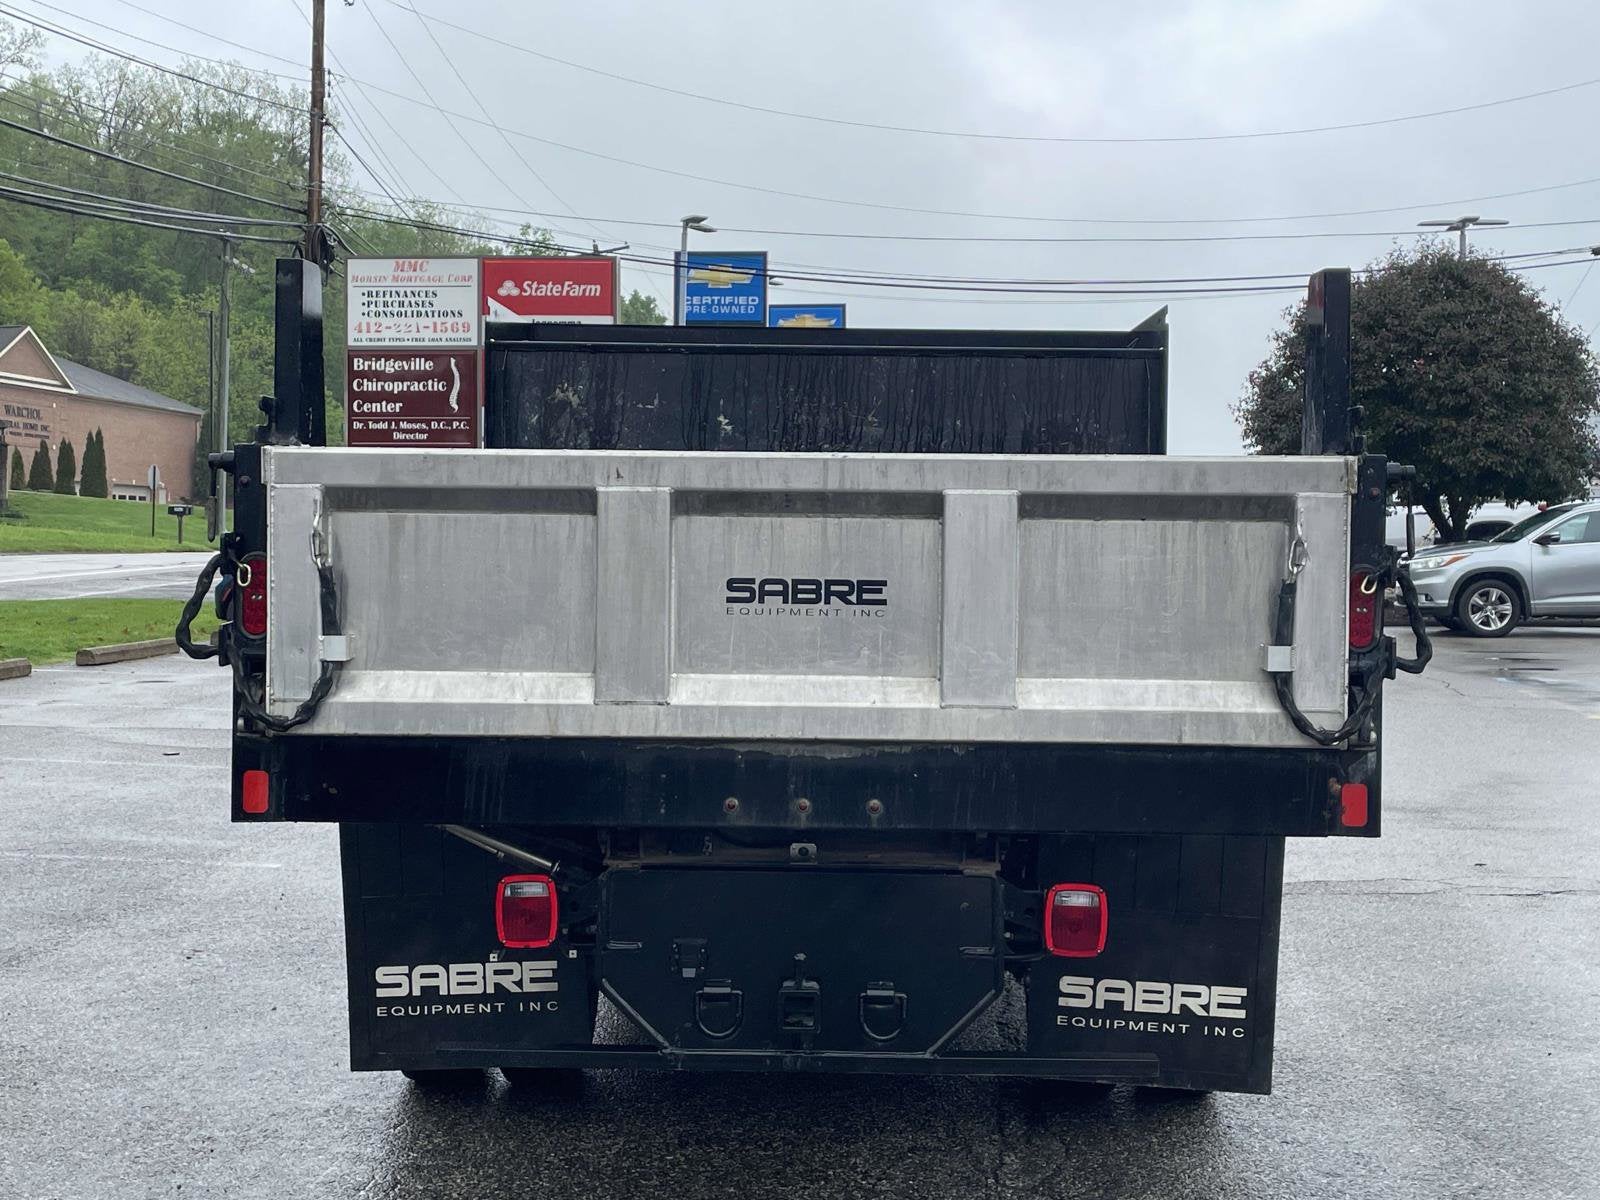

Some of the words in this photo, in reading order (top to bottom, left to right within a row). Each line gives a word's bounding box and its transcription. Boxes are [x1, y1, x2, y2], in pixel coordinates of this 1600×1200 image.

[393, 260, 430, 273] MMC
[685, 296, 759, 305] CERTIFIED
[686, 305, 755, 314] PRE-OWNED
[354, 321, 471, 334] 412-221-1569
[353, 357, 434, 374] Bridgeville
[352, 378, 447, 394] Chiropractic
[4, 404, 43, 420] WARCHOL
[352, 399, 403, 413] Center
[353, 421, 366, 430] Dr.
[368, 421, 388, 430] Todd
[391, 421, 398, 430] J.
[453, 421, 470, 430] P.C.
[393, 431, 429, 440] Director
[726, 577, 888, 606] SABRE
[726, 606, 842, 617] EQUIPMENT
[853, 608, 886, 618] INC
[375, 960, 559, 998] SABRE
[1058, 975, 1248, 1019] SABRE
[376, 1002, 505, 1017] EQUIPMENT
[519, 1001, 559, 1012] INC
[1056, 1015, 1191, 1034] EQUIPMENT
[1204, 1025, 1245, 1038] INC
